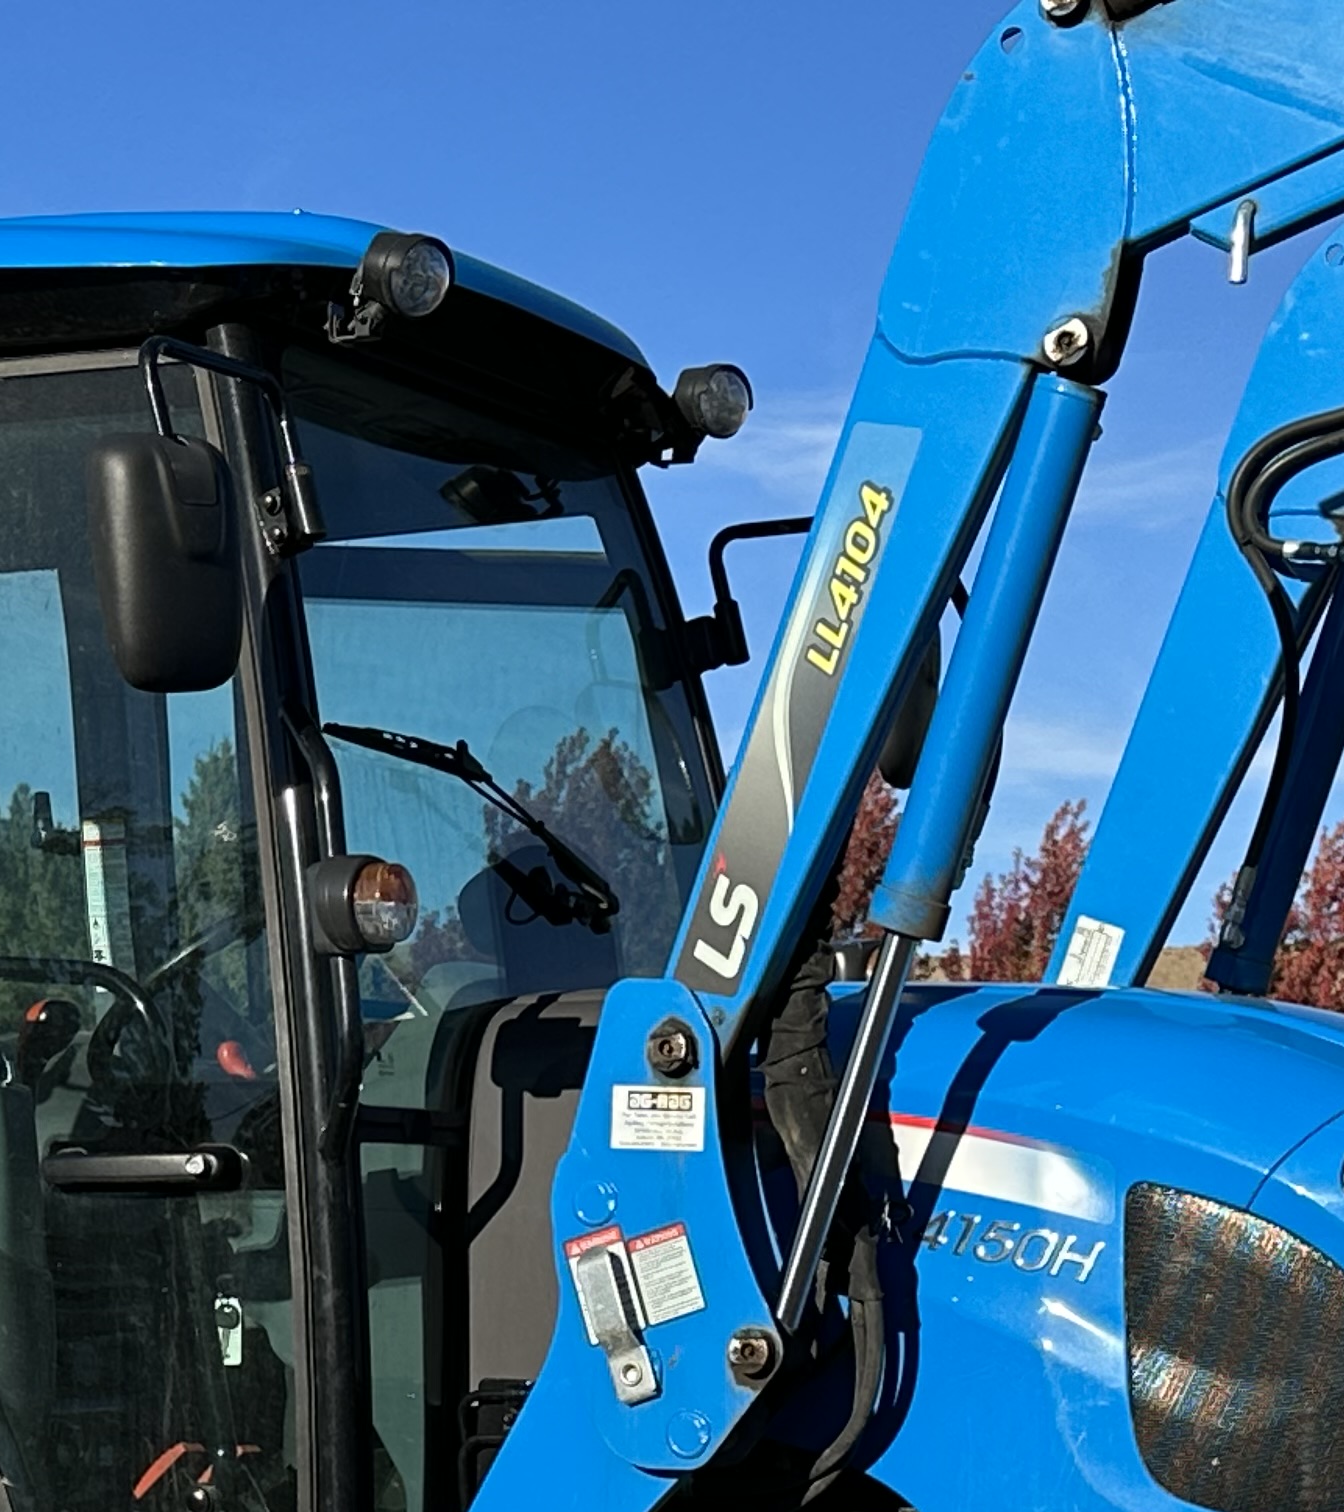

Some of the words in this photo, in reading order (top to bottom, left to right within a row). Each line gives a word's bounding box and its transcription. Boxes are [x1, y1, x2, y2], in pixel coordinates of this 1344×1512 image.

[806, 481, 893, 677] LL4104
[694, 872, 759, 980] LS
[922, 1209, 1106, 1285] 4150H
